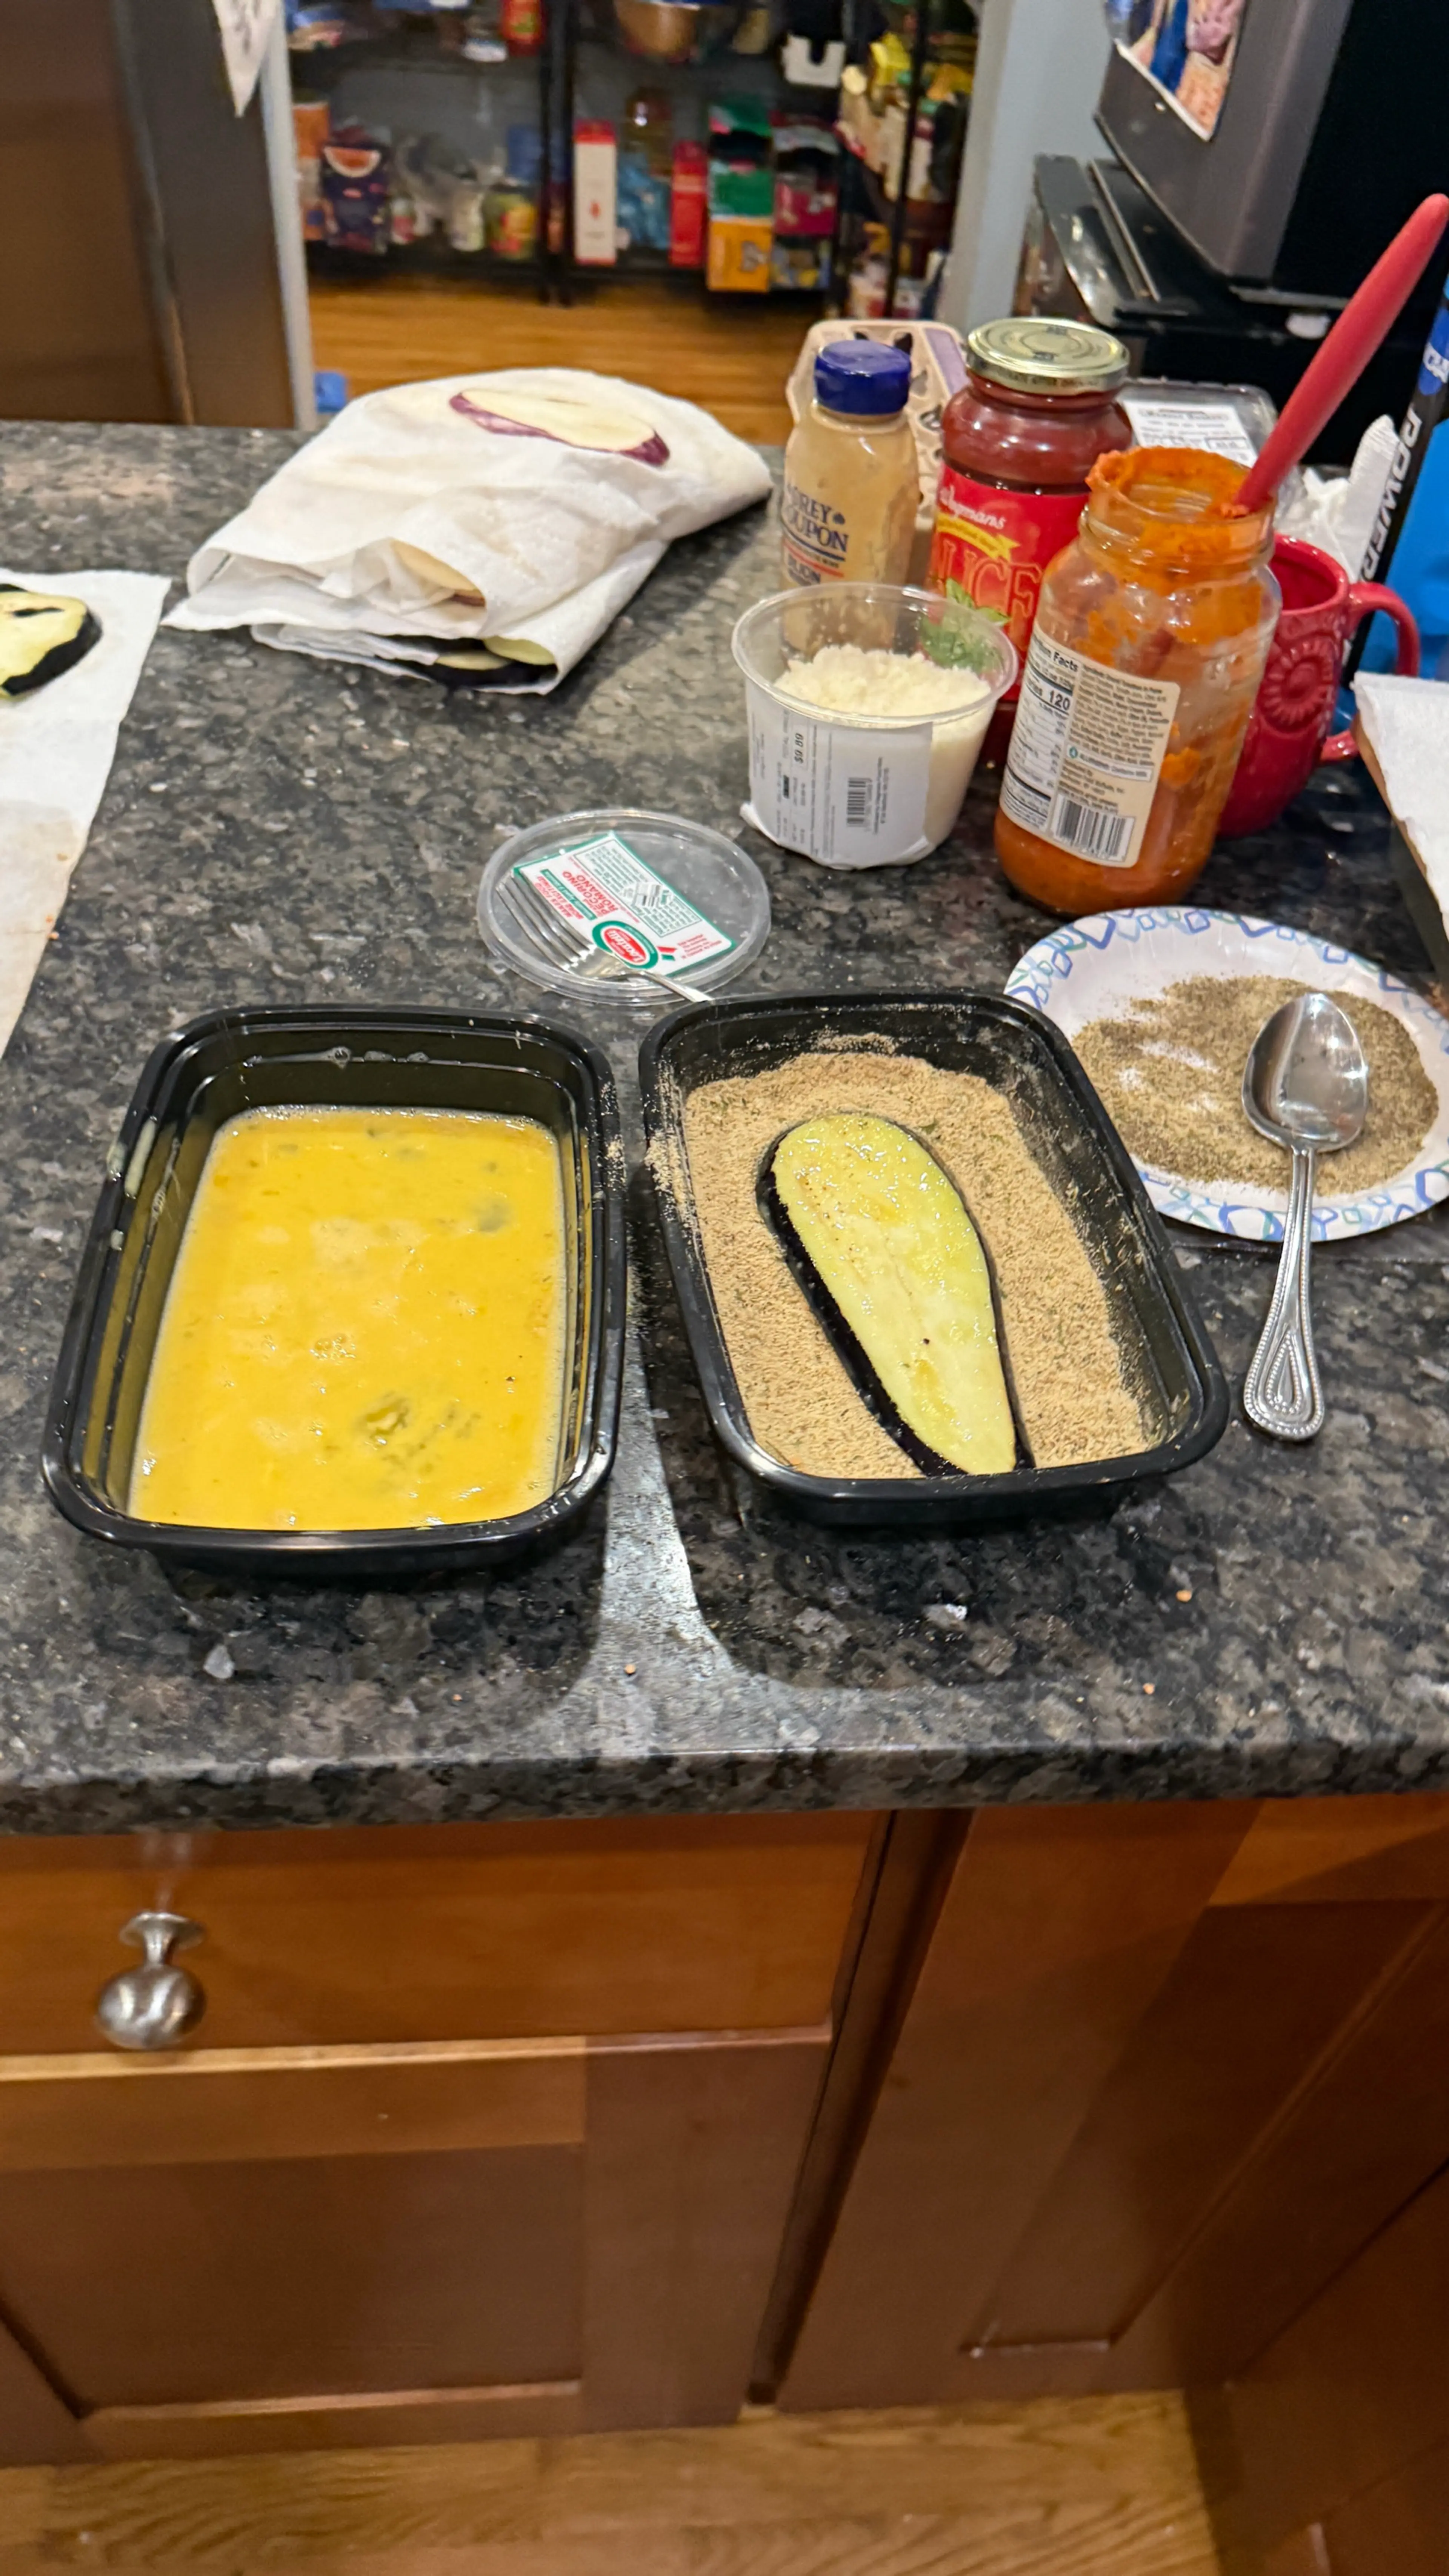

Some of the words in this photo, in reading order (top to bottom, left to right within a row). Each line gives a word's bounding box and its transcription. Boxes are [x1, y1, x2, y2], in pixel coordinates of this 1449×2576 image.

[787, 485, 832, 525] REY
[1049, 690, 1070, 711] 120
[562, 871, 610, 915] PECORINO
[576, 874, 618, 912] ROMANO
